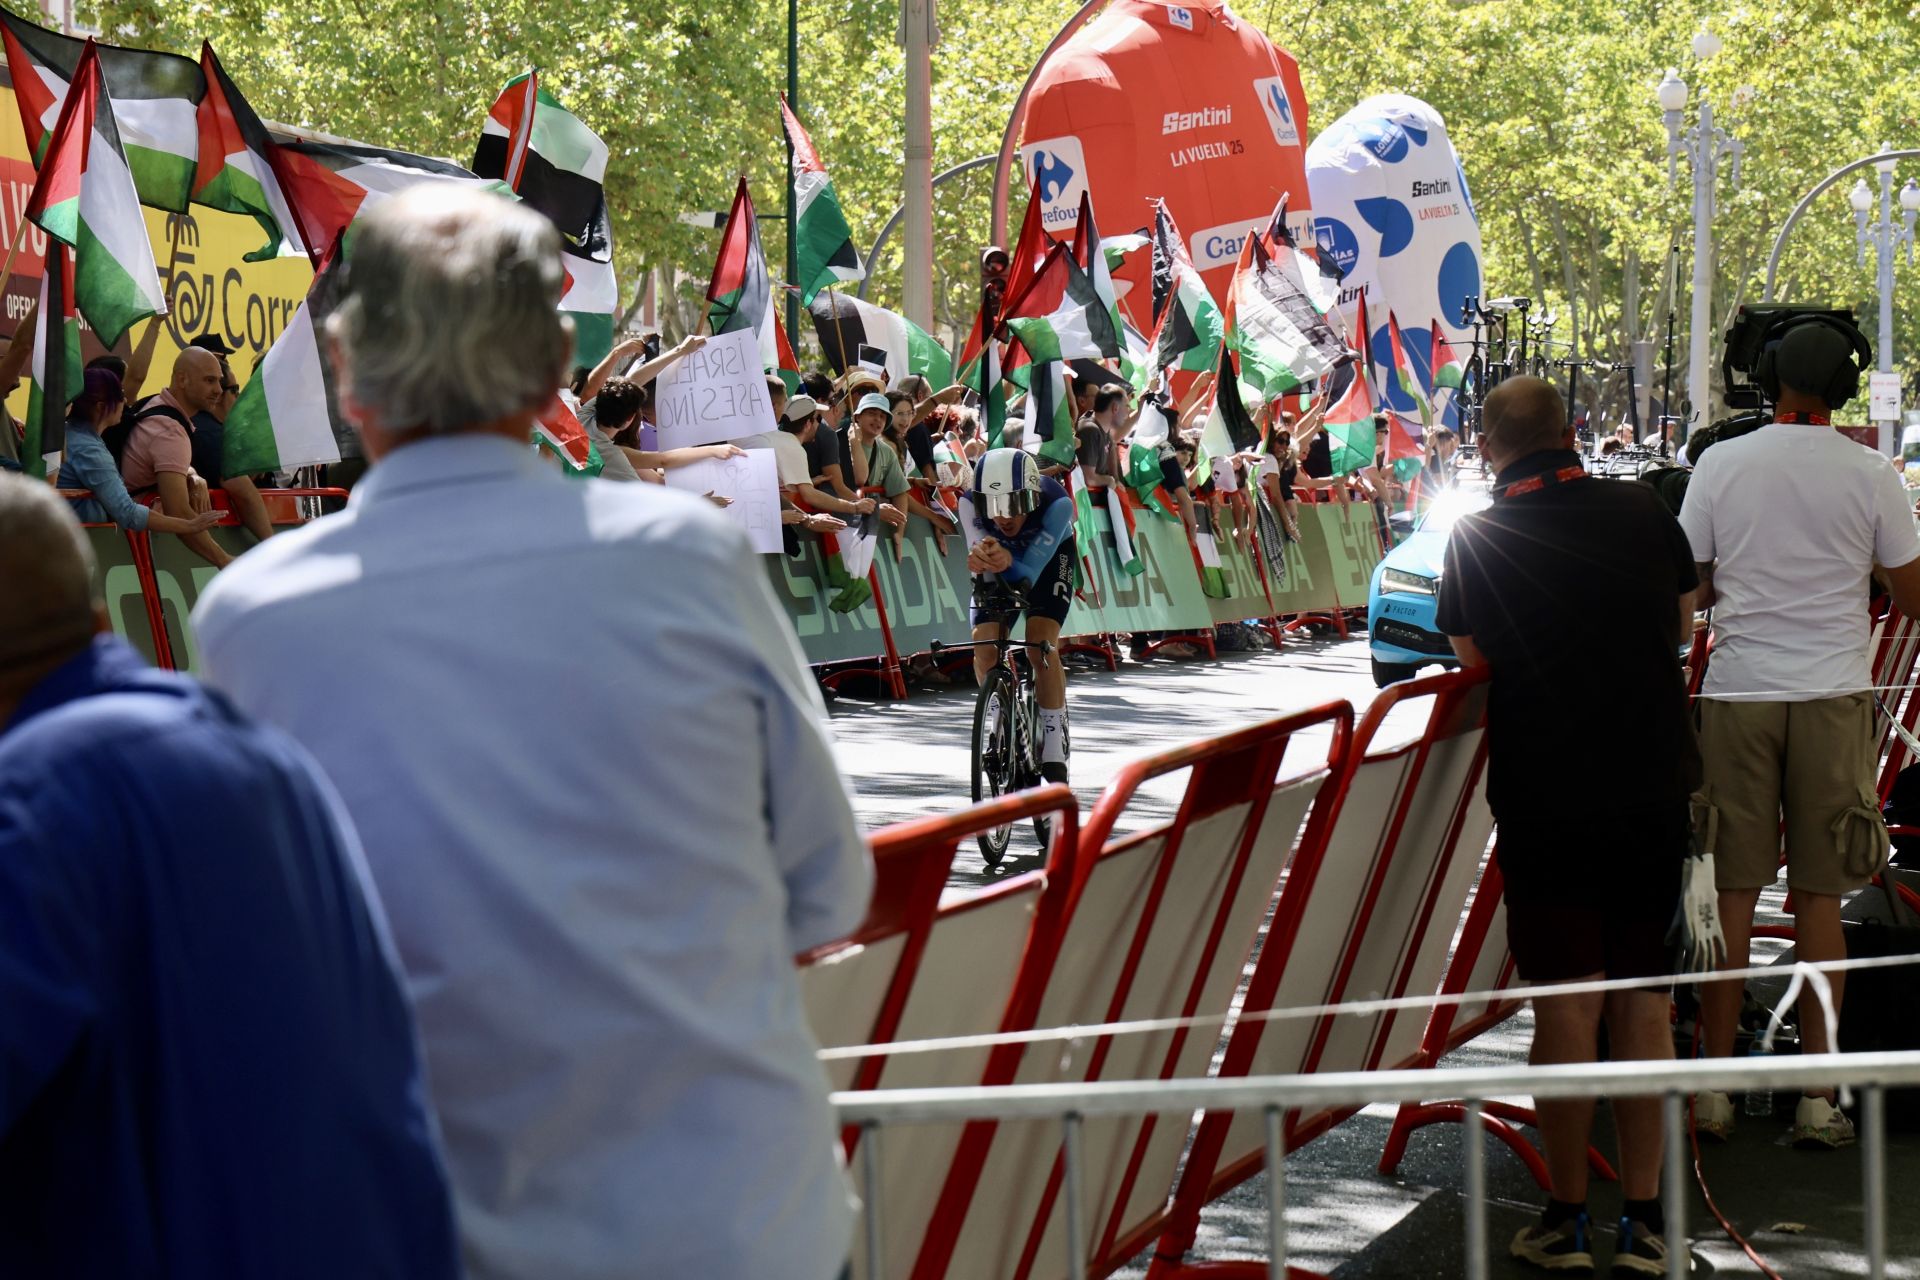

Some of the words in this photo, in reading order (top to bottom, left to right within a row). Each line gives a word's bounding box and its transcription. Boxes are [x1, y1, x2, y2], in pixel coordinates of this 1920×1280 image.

[1162, 104, 1232, 136] Santini
[1170, 150, 1188, 168] LA
[1186, 141, 1230, 164] VUELTA
[1229, 139, 1245, 155] 25
[1411, 177, 1452, 198] Santini
[1042, 205, 1081, 223] refou
[222, 267, 303, 353] Corr
[1392, 605, 1417, 617] FACTOR
